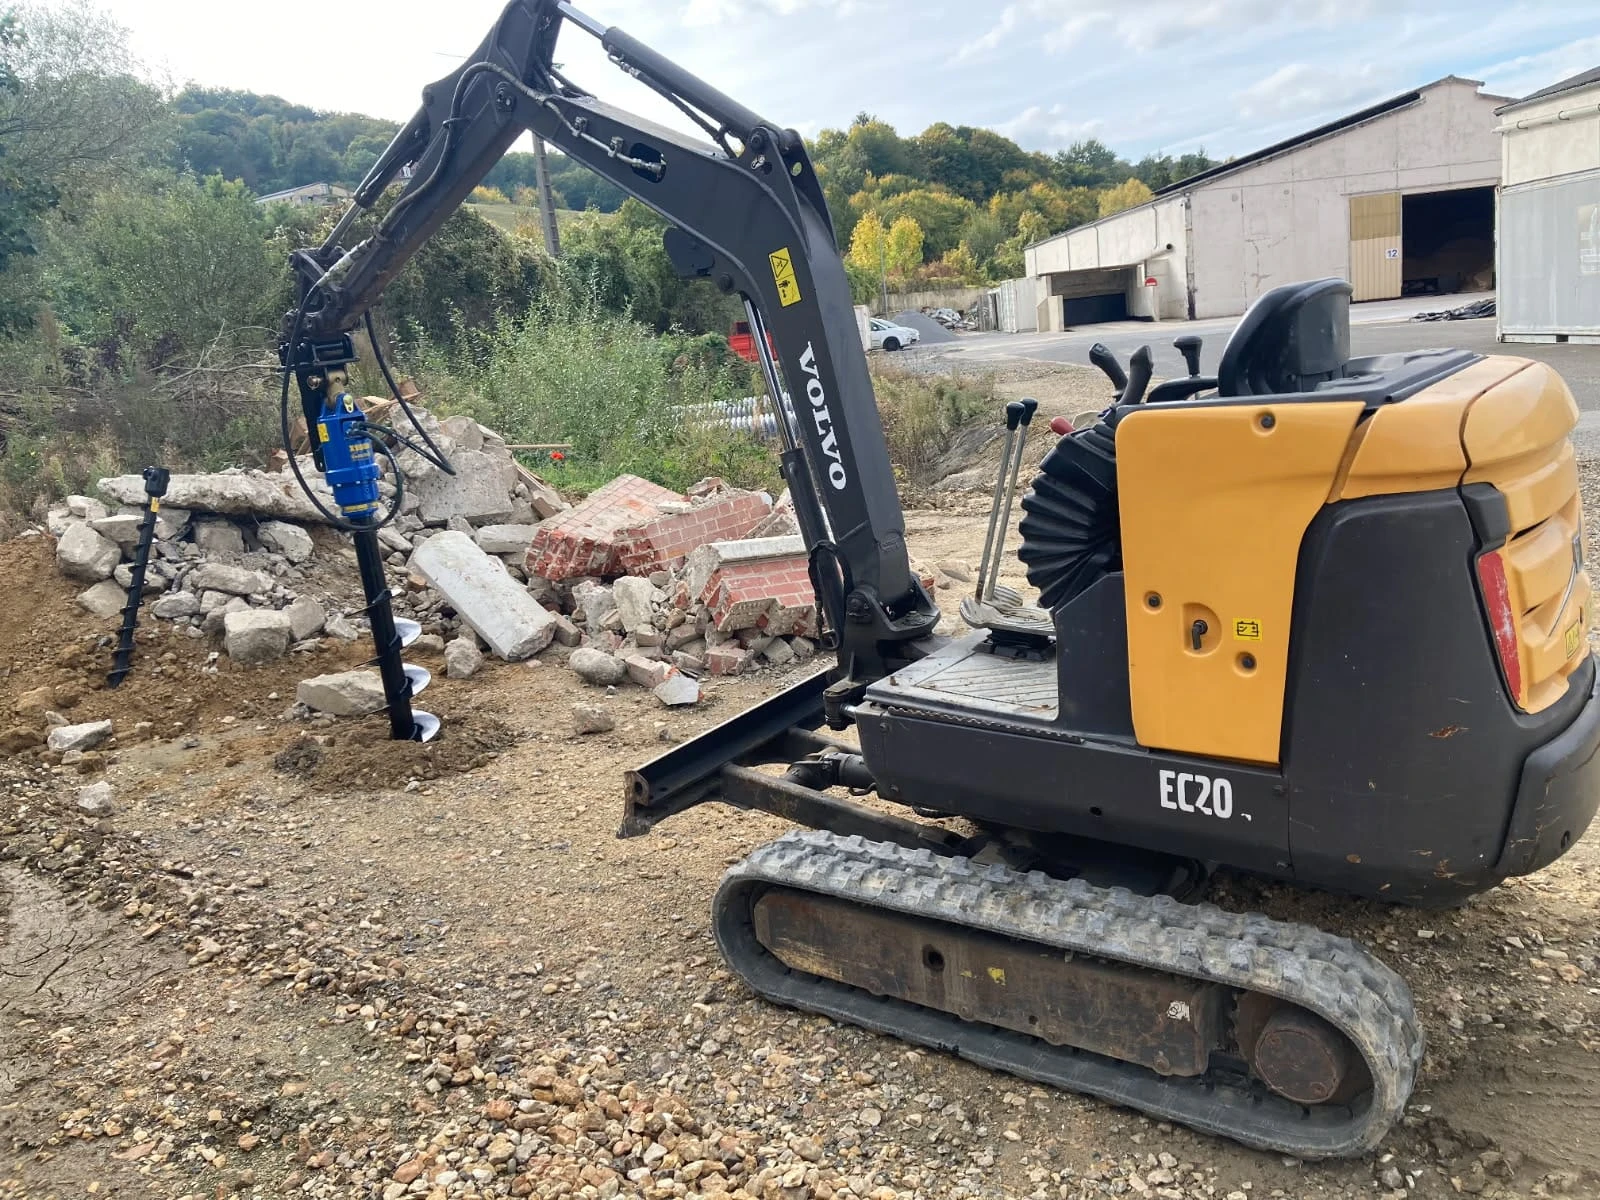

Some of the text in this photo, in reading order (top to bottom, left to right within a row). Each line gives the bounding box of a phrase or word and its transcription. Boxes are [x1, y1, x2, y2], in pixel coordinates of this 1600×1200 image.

[1387, 249, 1398, 258] 12
[798, 341, 847, 490] VOLVO
[1159, 769, 1233, 819] EC20
